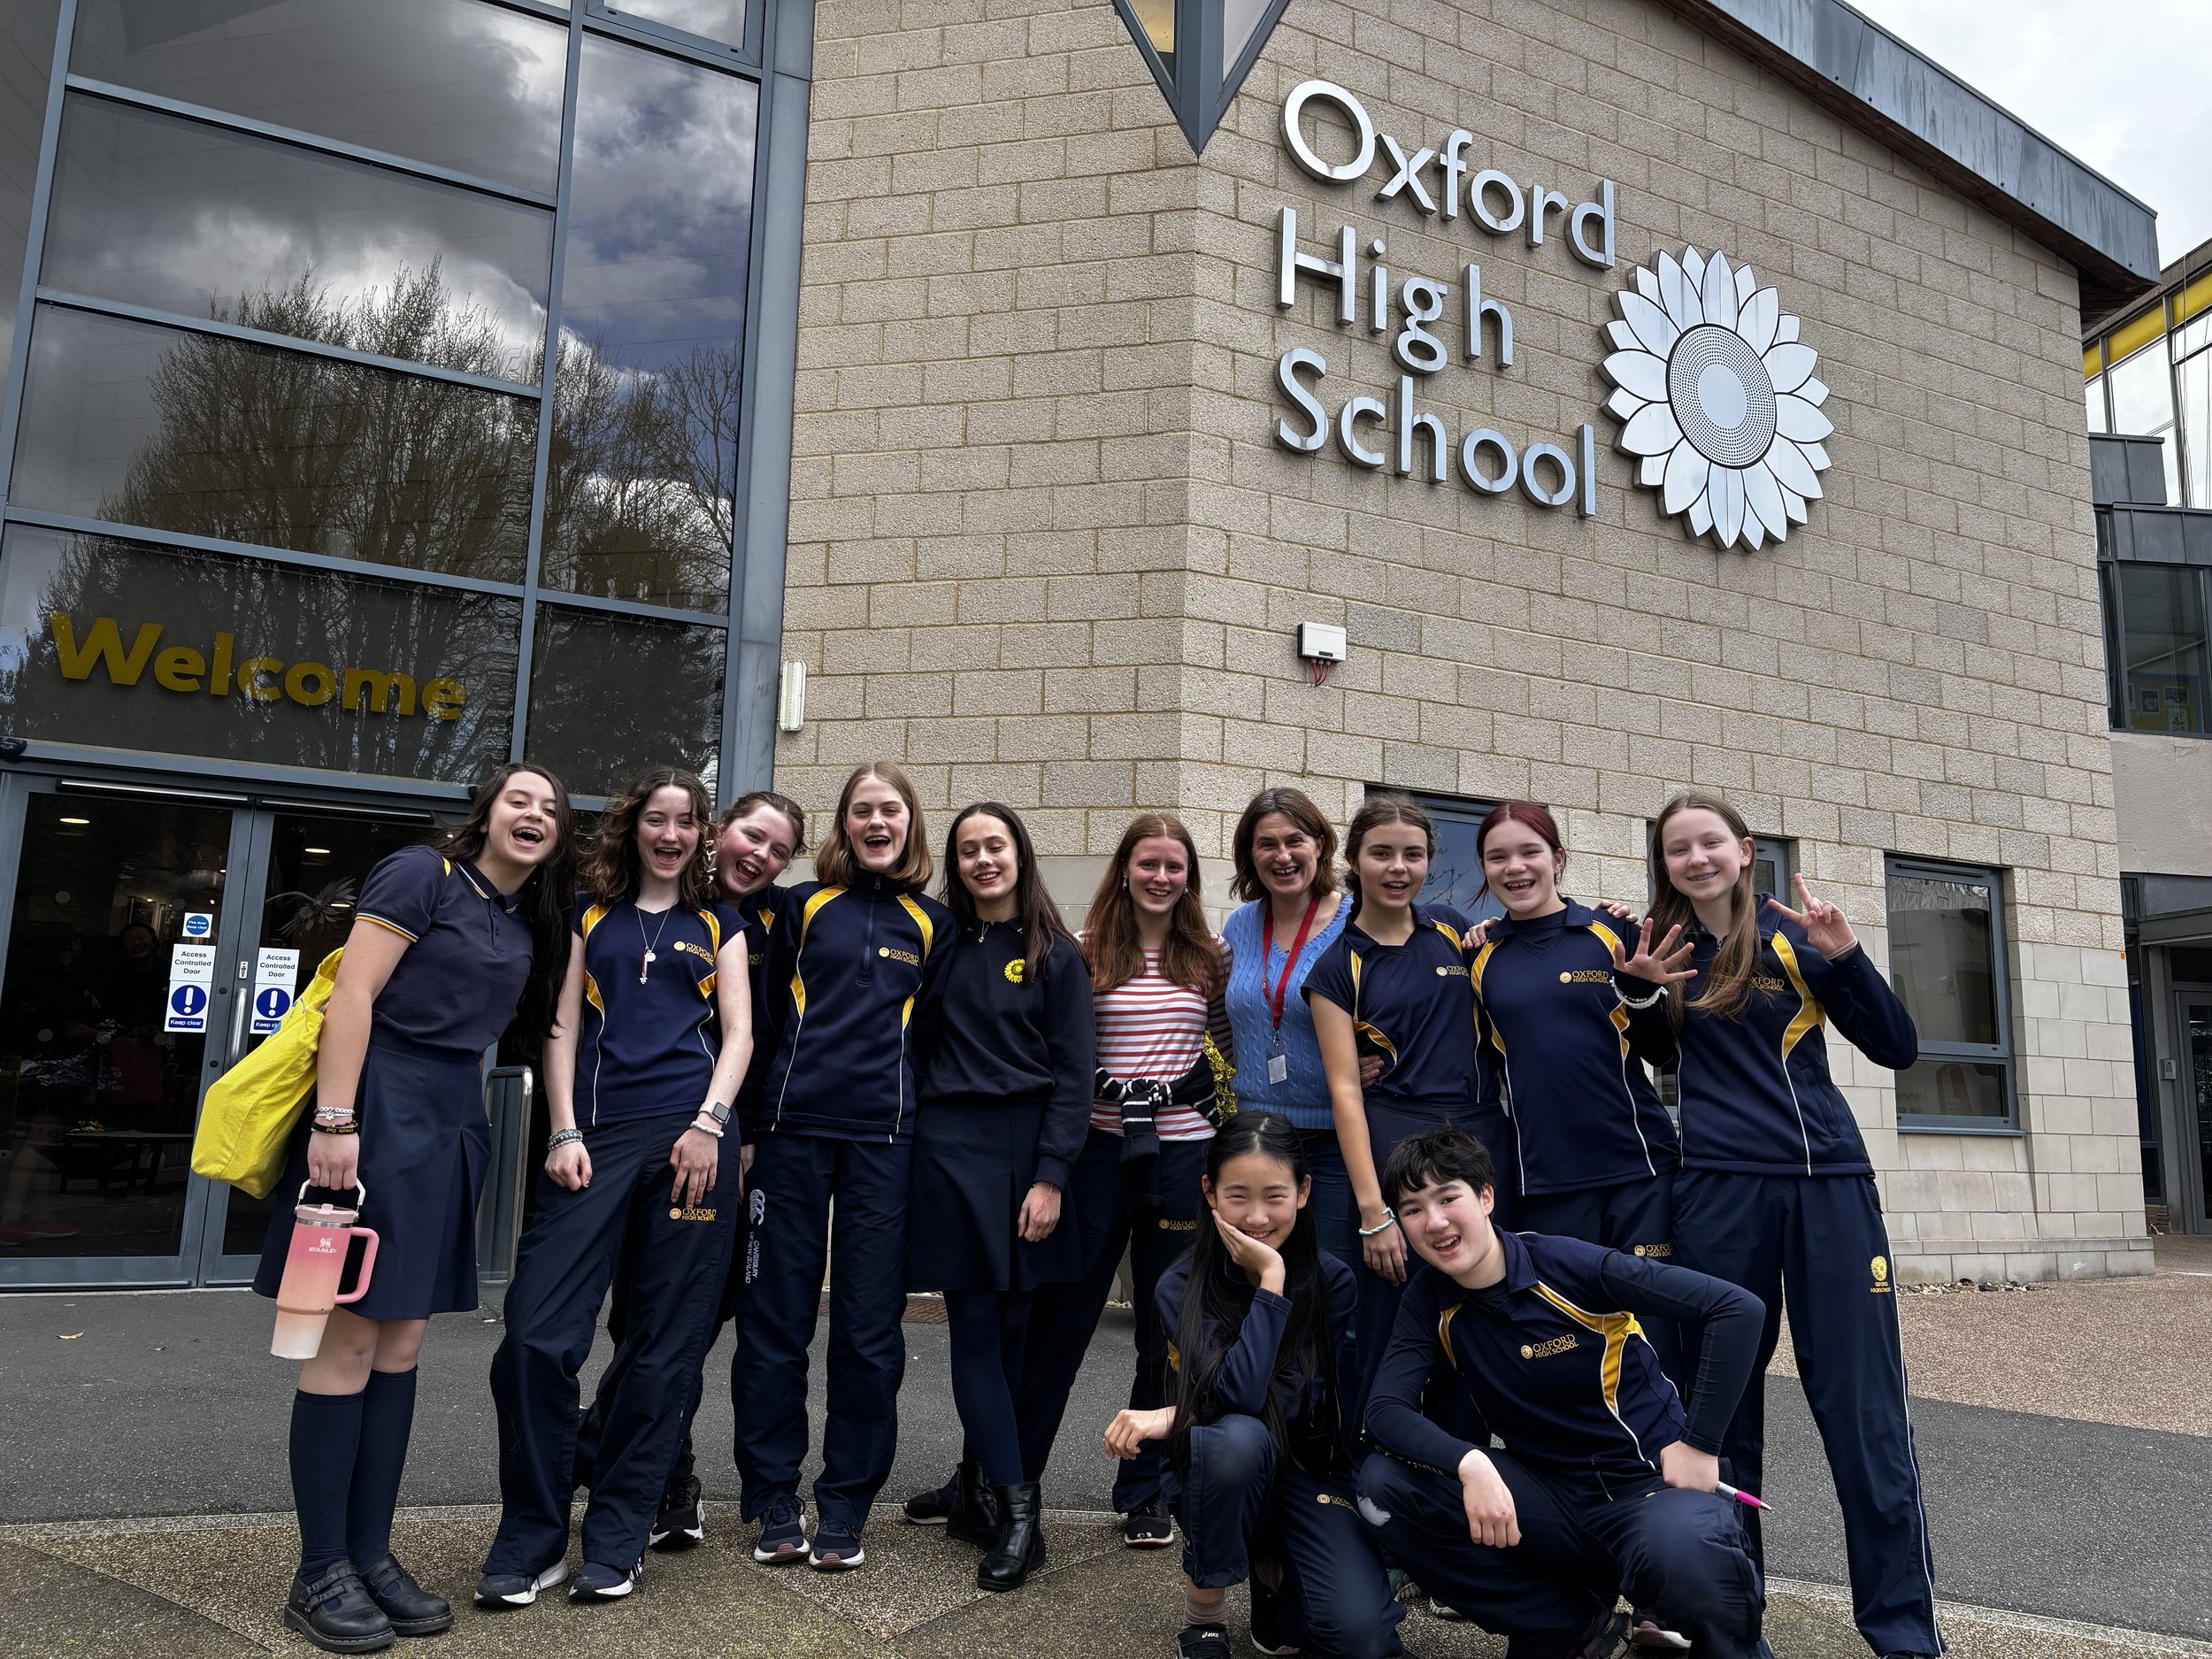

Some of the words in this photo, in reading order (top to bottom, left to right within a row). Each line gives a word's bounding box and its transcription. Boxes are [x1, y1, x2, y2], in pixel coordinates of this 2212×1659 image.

[1280, 80, 1614, 269] Oxford
[1277, 206, 1512, 373] High
[1274, 348, 1595, 517] School
[50, 611, 466, 720] Welcome
[890, 949, 919, 963] OXFORD
[1572, 970, 1609, 979] OXFORD
[1751, 977, 1785, 987] XFORD
[682, 1208, 717, 1217] OXFORD
[1532, 1334, 1575, 1353] OXFORD
[1552, 1341, 1579, 1355] SCHOOL
